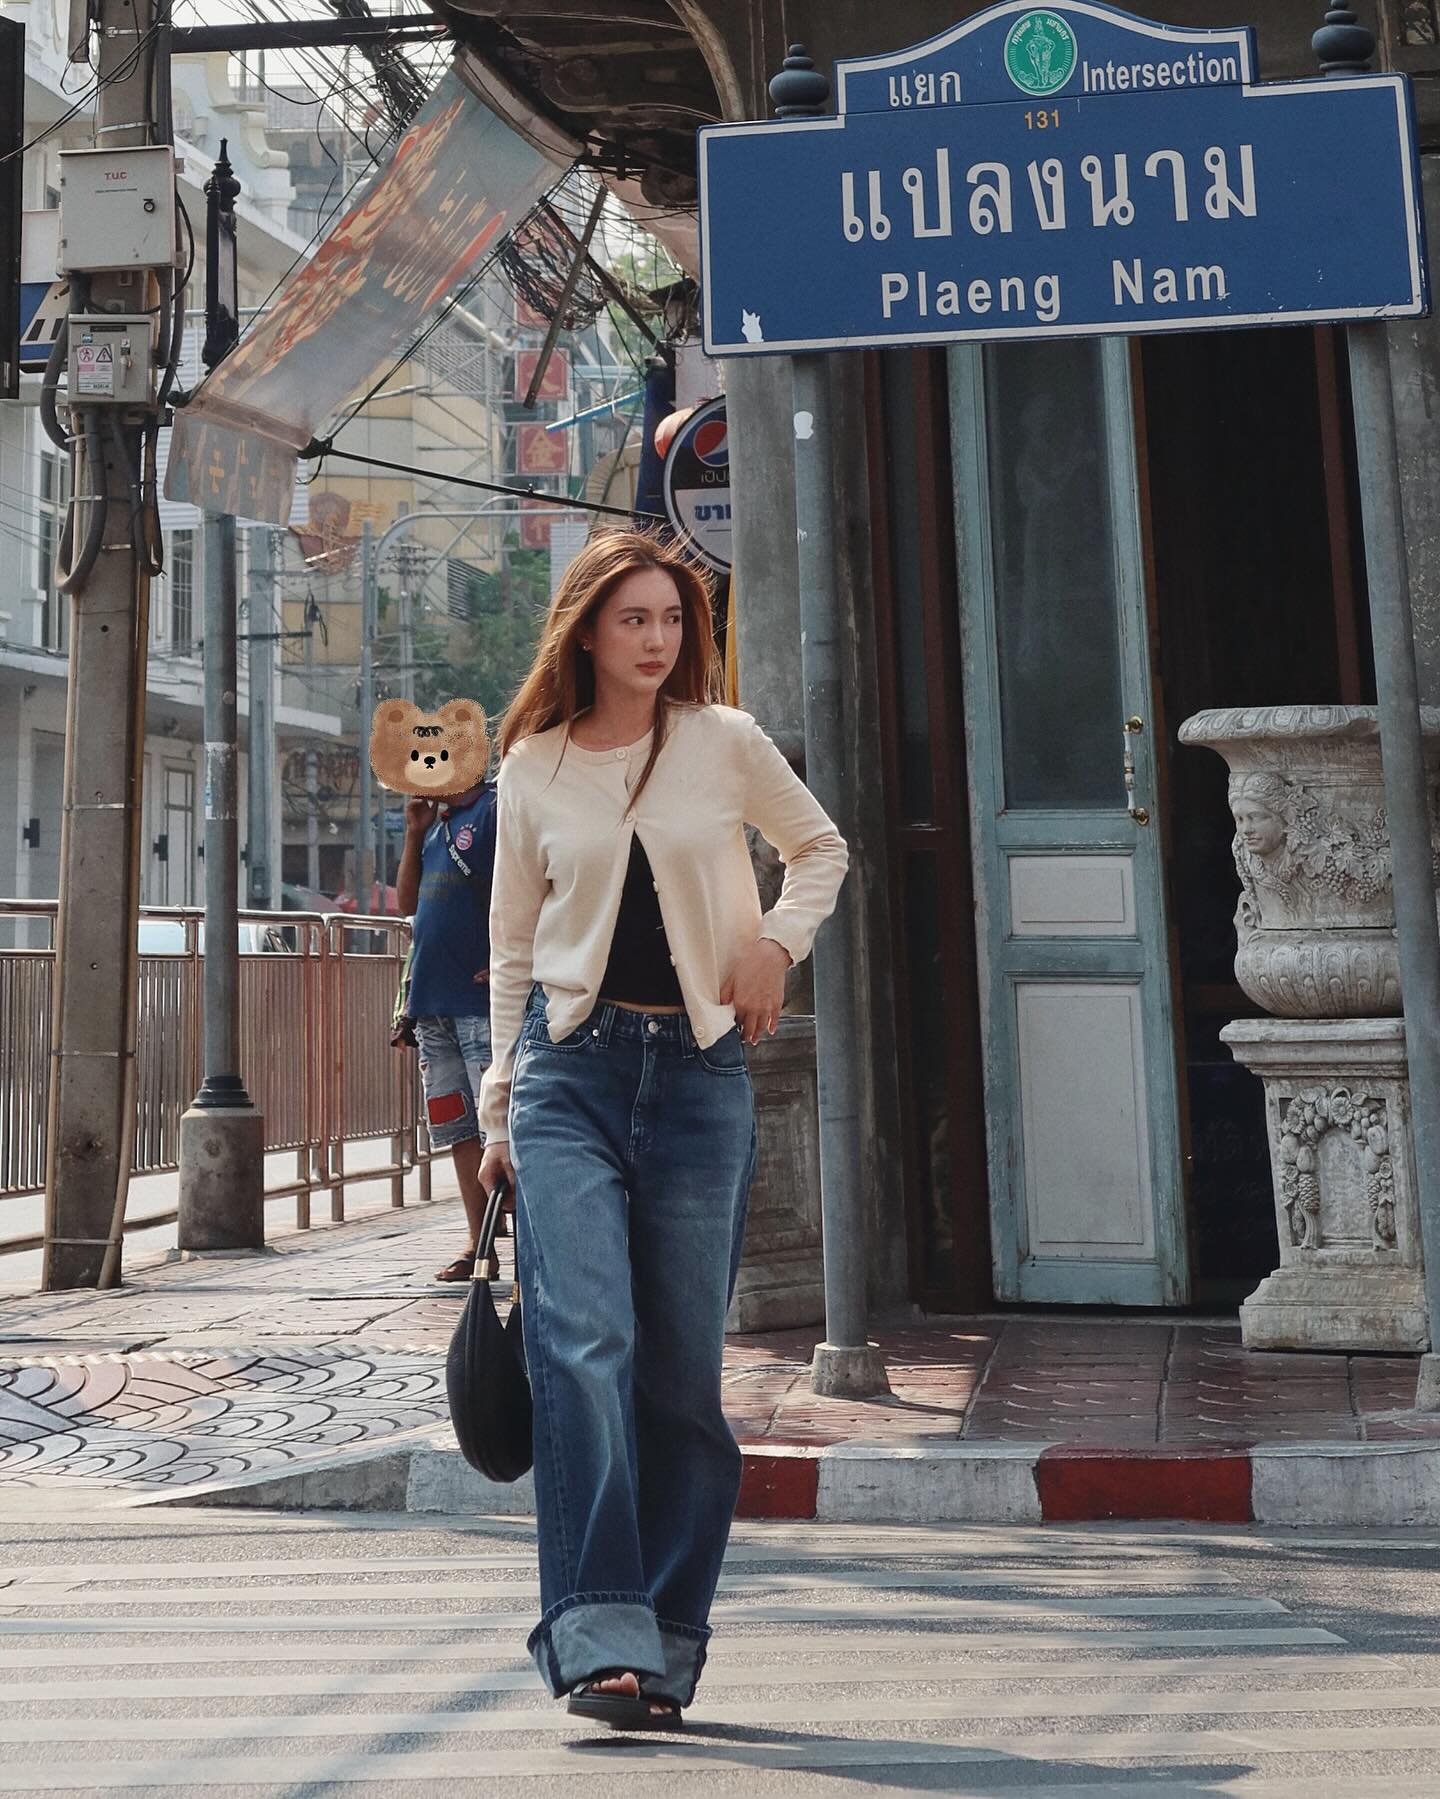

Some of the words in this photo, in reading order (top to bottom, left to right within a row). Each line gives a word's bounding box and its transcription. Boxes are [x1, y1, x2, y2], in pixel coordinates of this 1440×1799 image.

[888, 71, 962, 107] แยก
[1082, 52, 1238, 93] Intersection
[1024, 110, 1061, 130] 131
[841, 144, 1257, 242] แปลงนาม
[880, 270, 1061, 322] Plaeng
[1111, 257, 1228, 306] Nam
[448, 843, 472, 877] Supreme
